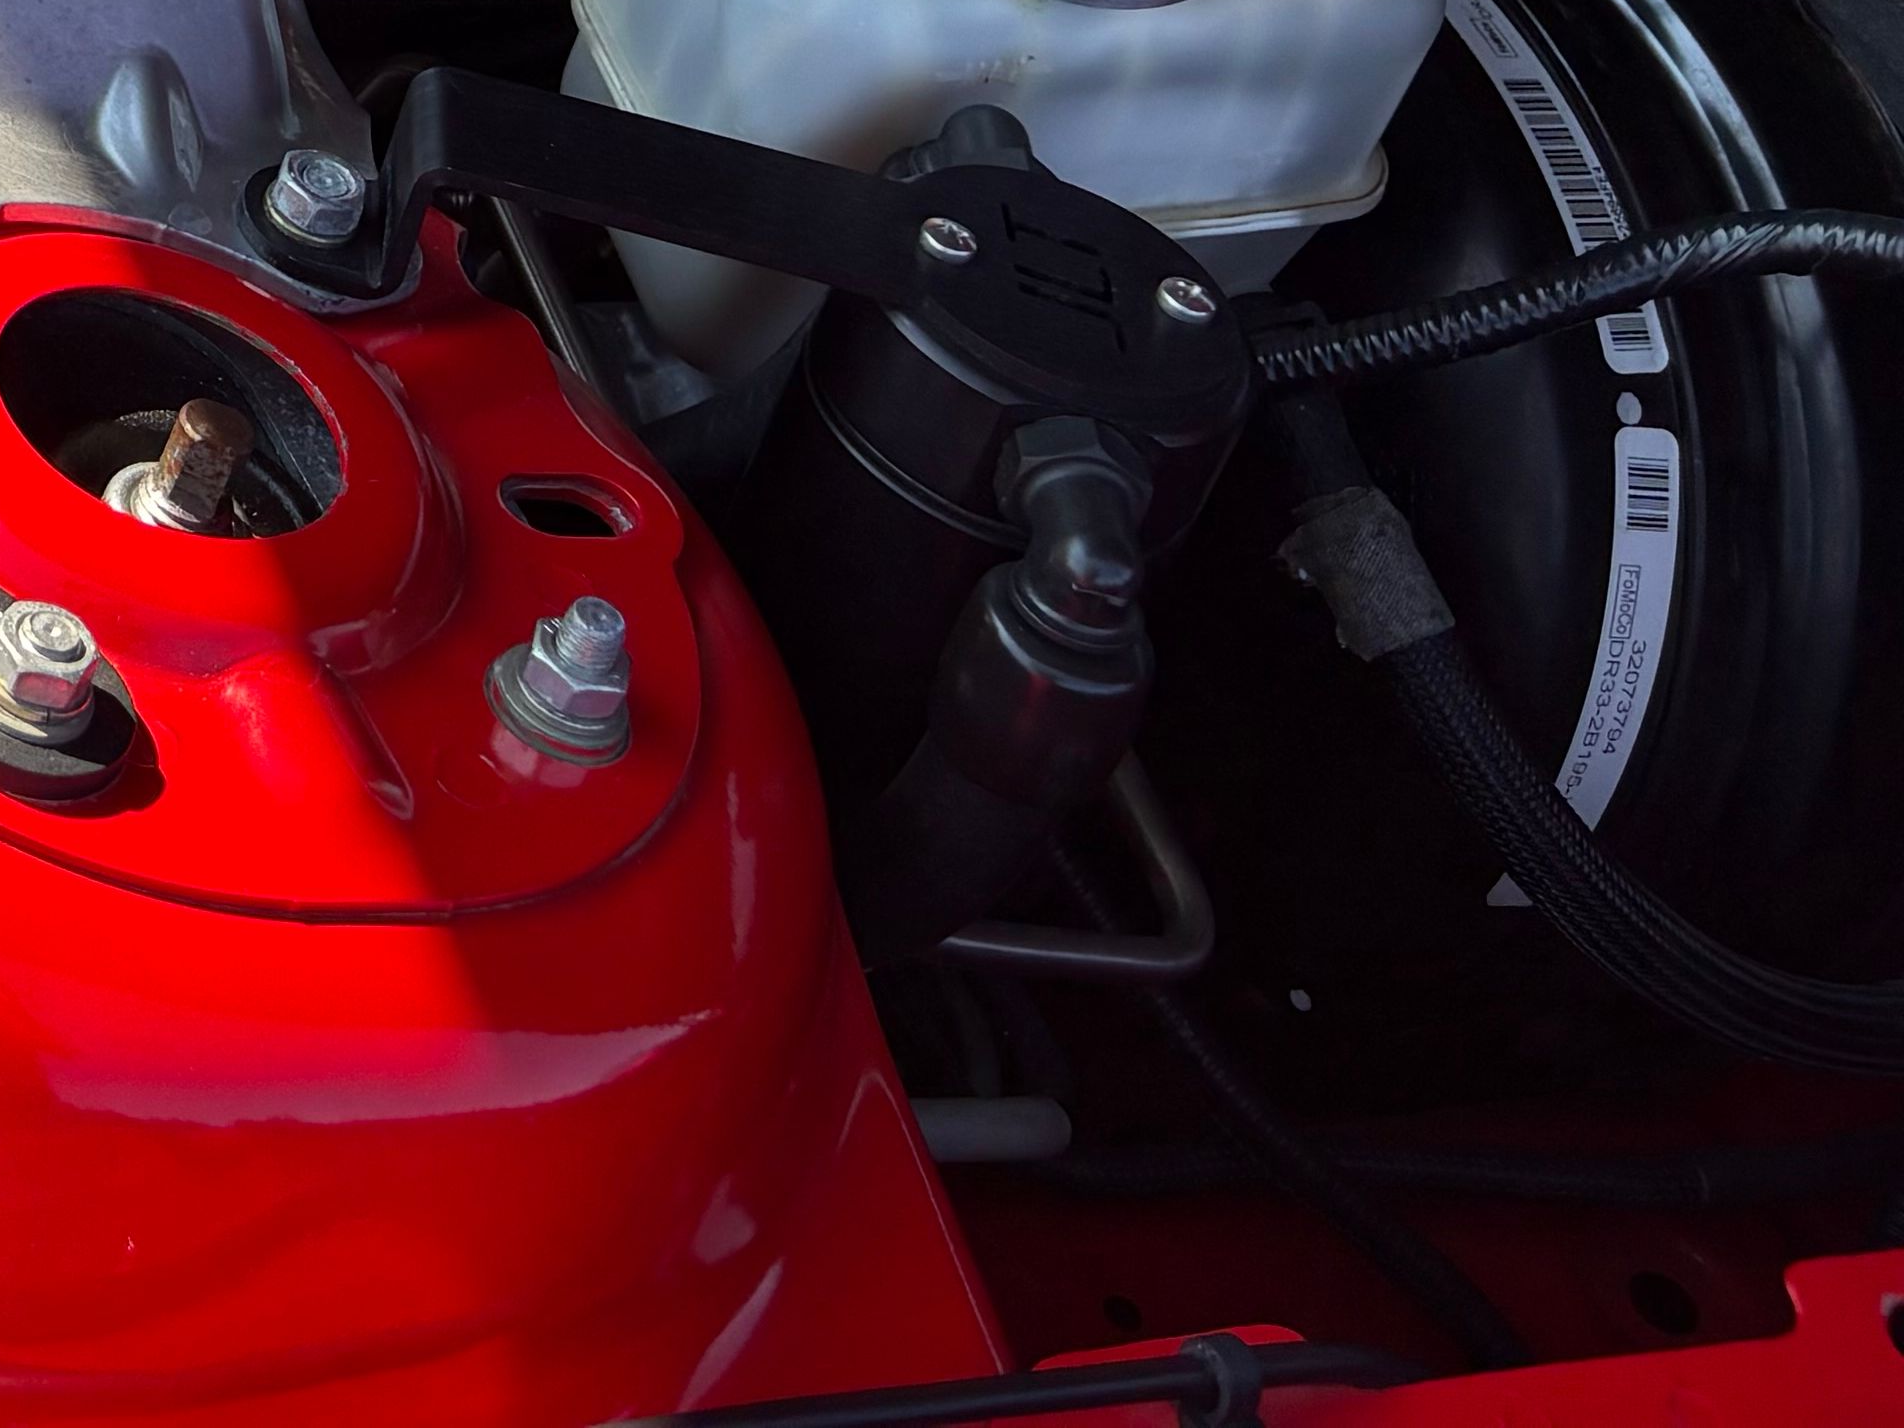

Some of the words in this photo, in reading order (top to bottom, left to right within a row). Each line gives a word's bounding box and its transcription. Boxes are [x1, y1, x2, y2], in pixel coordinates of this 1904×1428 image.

[1614, 568, 1640, 635] FoMoCo
[1564, 639, 1625, 797] DR33-2B195-
[1602, 639, 1647, 754] 32073794
